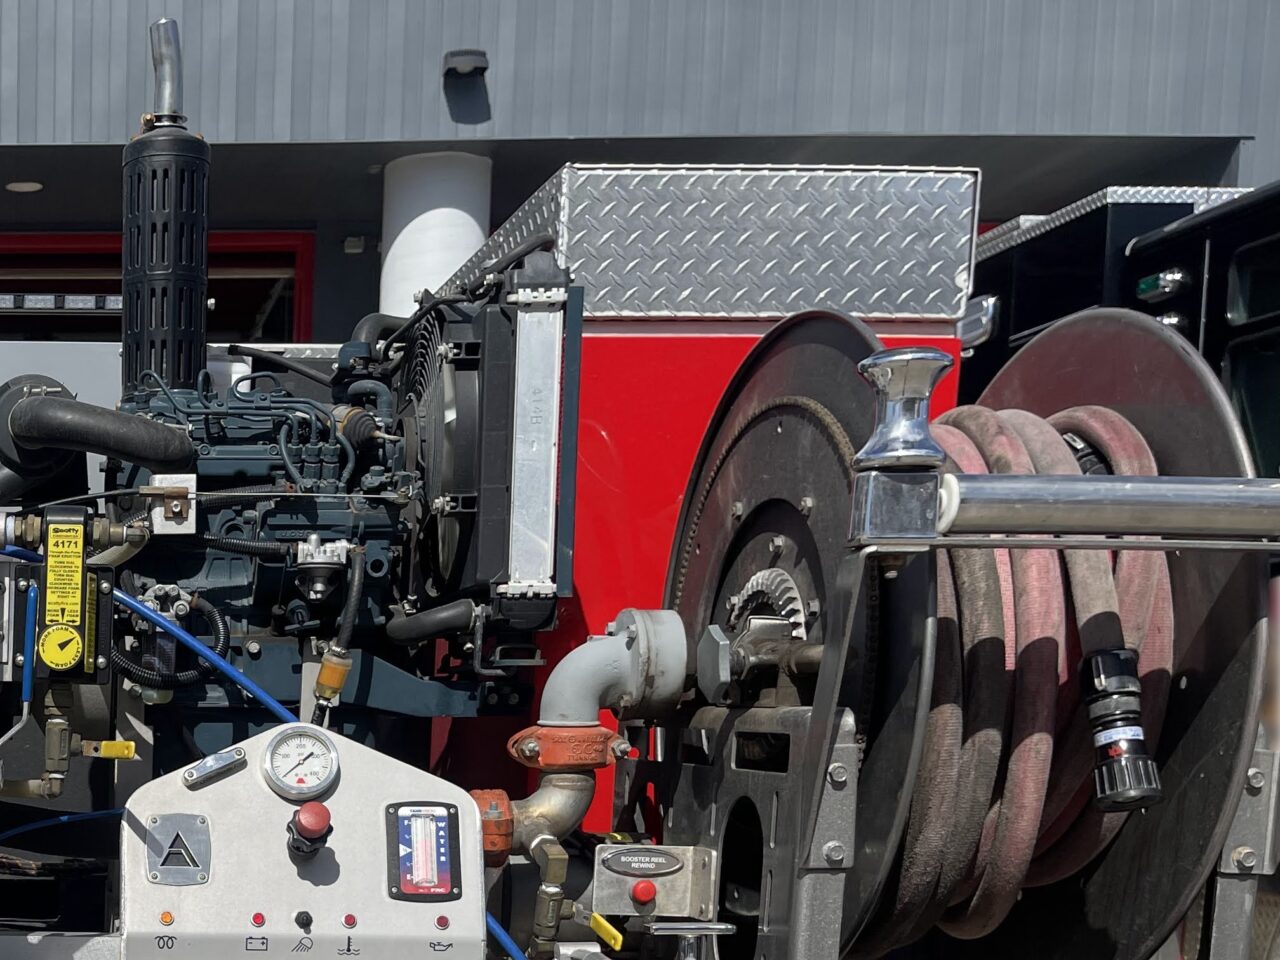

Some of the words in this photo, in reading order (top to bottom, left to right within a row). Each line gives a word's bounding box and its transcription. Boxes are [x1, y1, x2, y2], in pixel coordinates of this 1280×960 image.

[52, 540, 78, 548] 4171
[40, 631, 52, 647] MORE
[71, 647, 81, 661] LESS
[54, 660, 73, 668] FOAM
[436, 821, 447, 862] WATER
